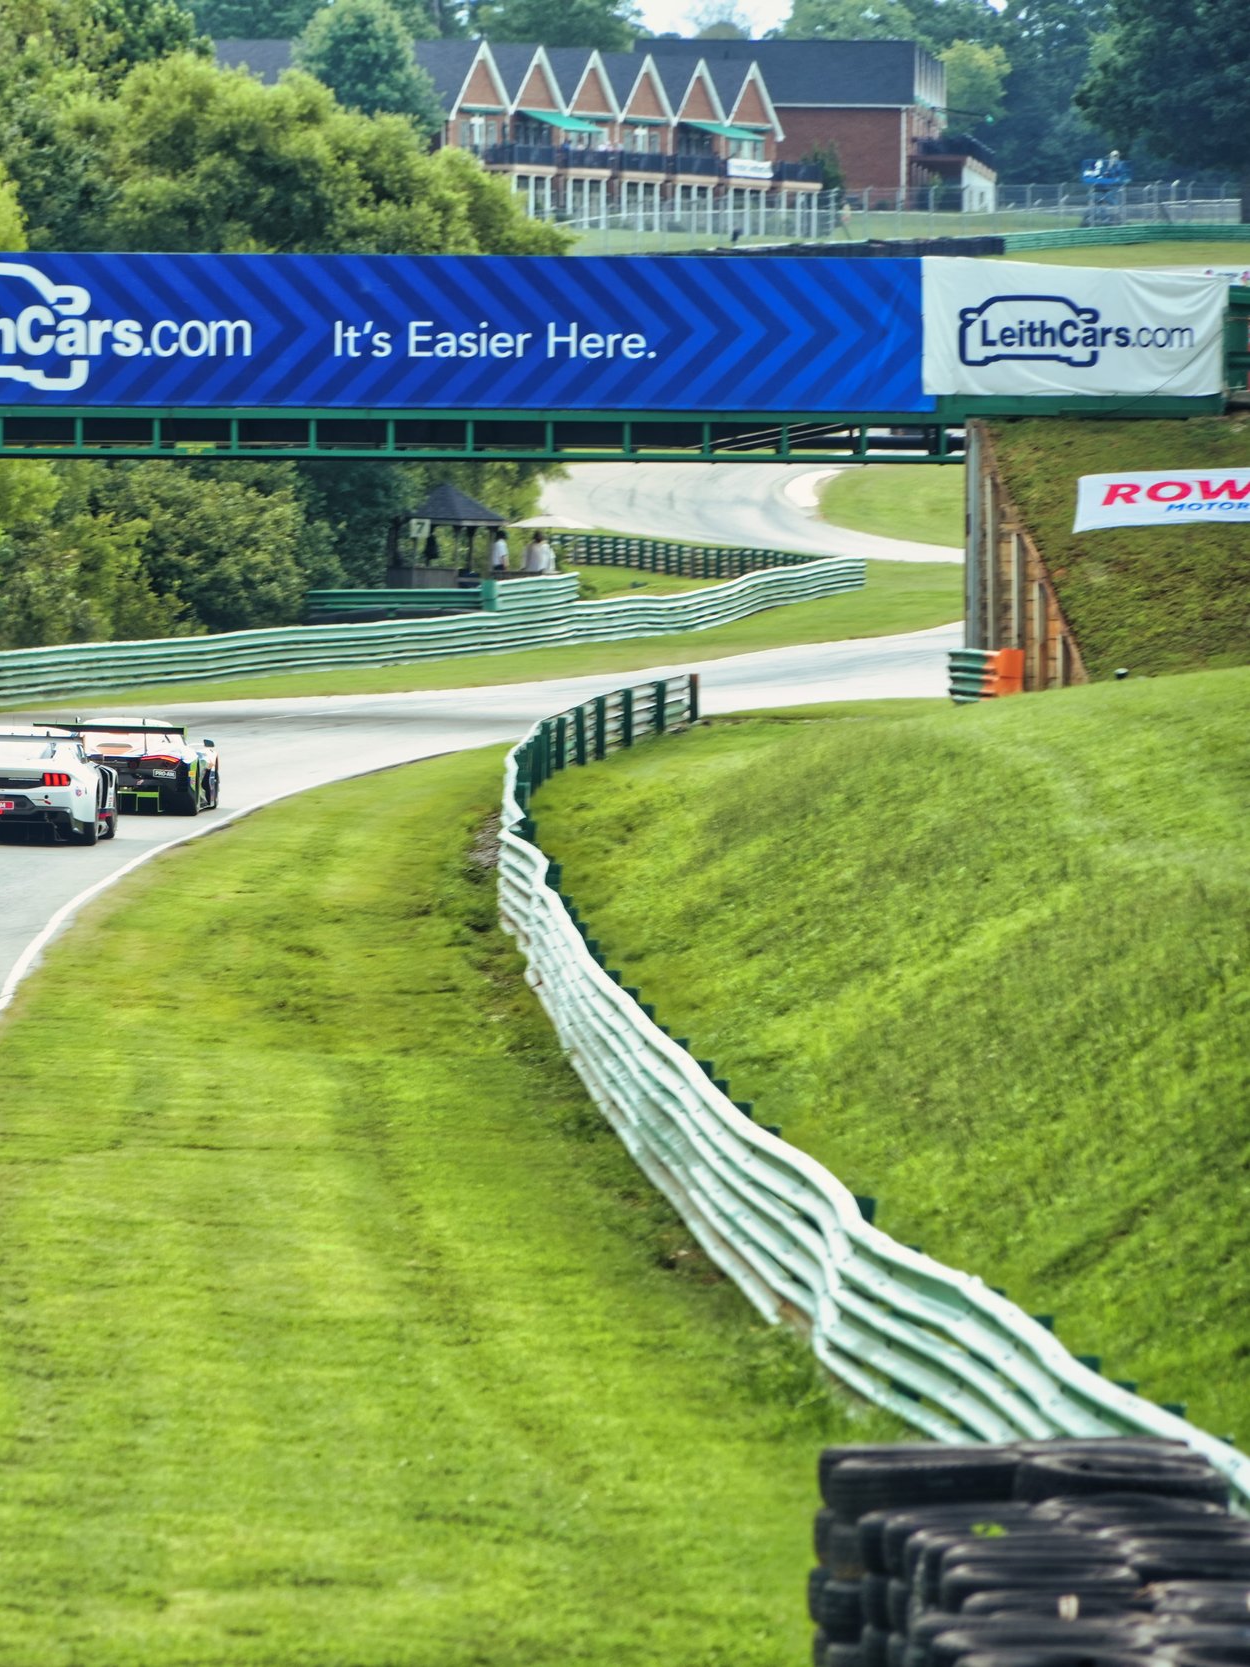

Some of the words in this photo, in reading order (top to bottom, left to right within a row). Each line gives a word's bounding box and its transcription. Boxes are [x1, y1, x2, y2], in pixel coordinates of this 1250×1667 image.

[333, 319, 393, 358] It's
[407, 320, 533, 358] Easier
[546, 321, 658, 359] Here.
[981, 319, 1195, 348] LeithCars.com
[415, 521, 426, 534] 7
